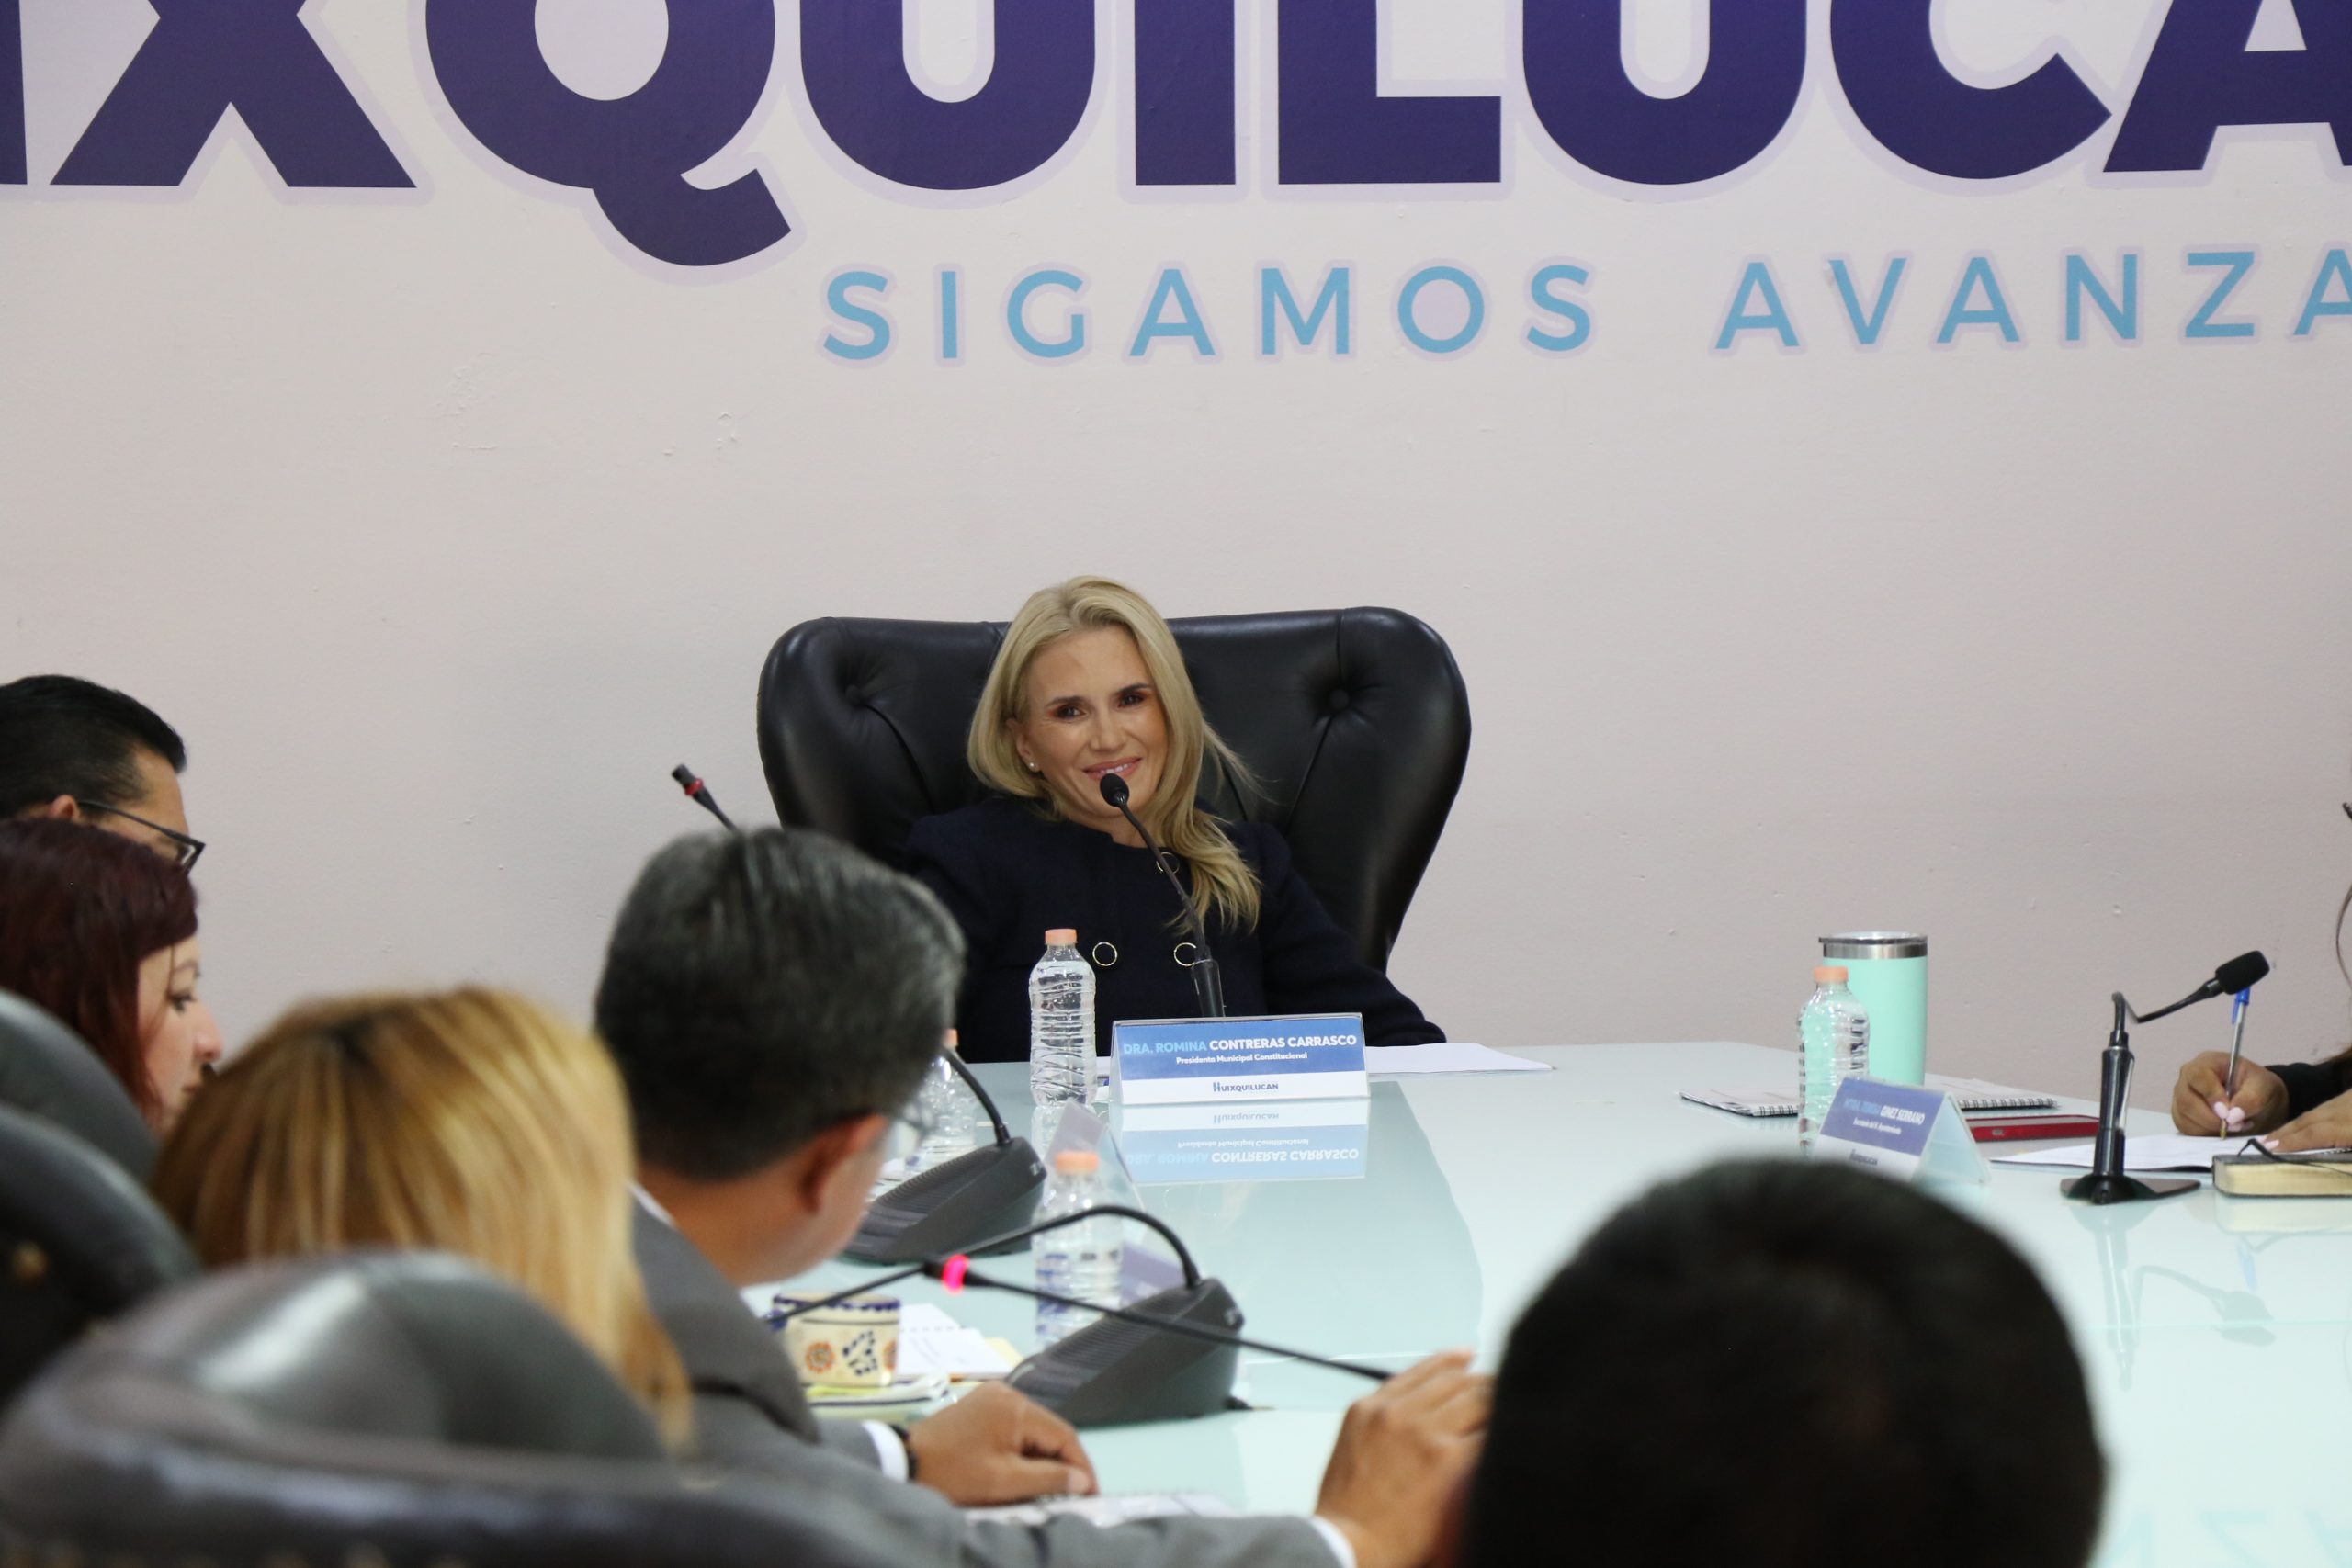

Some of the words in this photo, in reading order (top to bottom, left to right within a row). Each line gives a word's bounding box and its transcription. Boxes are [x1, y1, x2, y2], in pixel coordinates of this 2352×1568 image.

[0, 0, 2352, 265] XQUILUC
[823, 264, 1590, 359] SIGAMOS
[1715, 249, 2352, 350] AVANZA
[1123, 1043, 1154, 1055] DRA.
[1156, 1041, 1207, 1053] ROMINA
[1209, 1037, 1285, 1051] CONTRERAS
[1287, 1034, 1357, 1047] CARRASCO
[1216, 1054, 1252, 1064] Municipal
[1254, 1052, 1308, 1061] Constitucional
